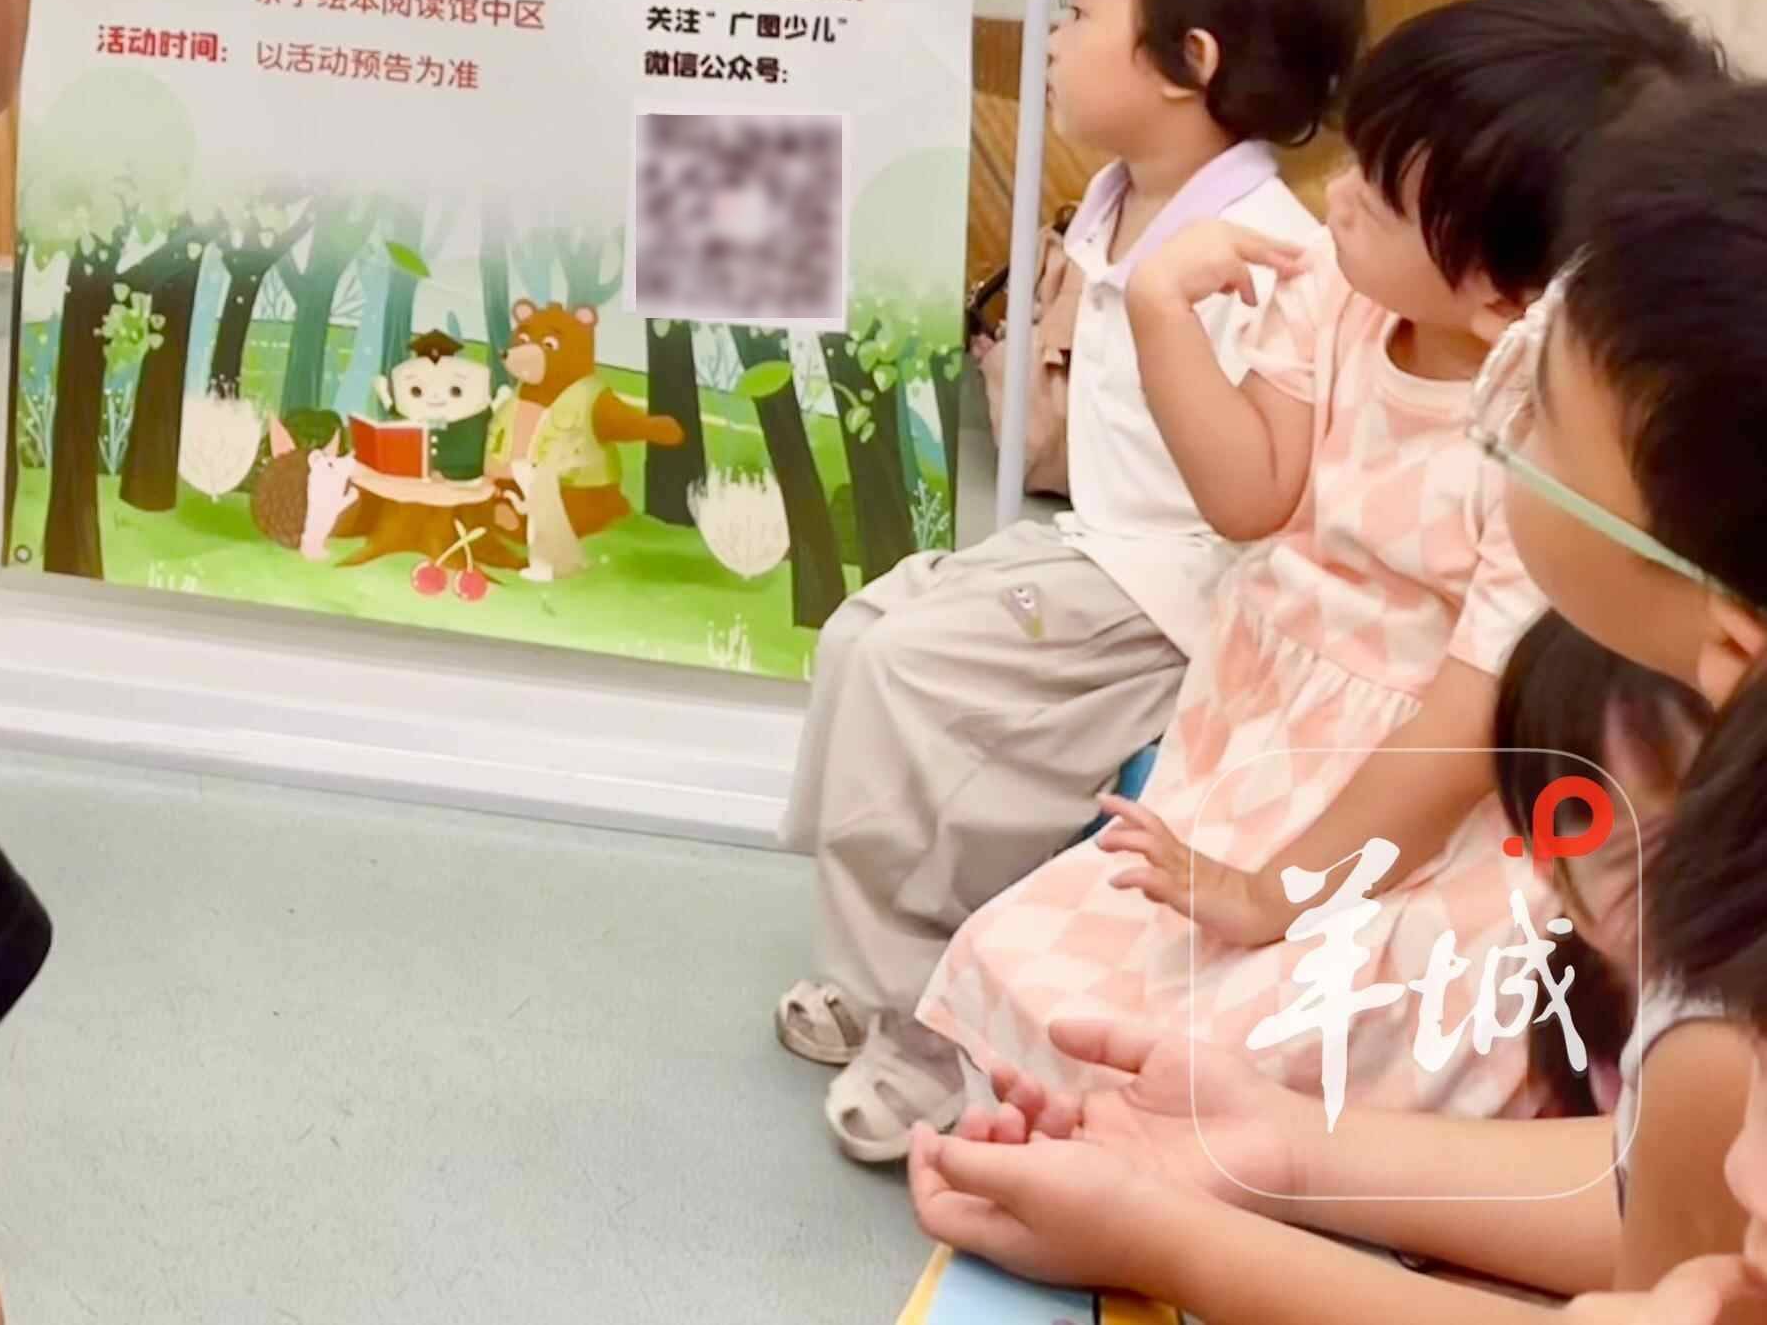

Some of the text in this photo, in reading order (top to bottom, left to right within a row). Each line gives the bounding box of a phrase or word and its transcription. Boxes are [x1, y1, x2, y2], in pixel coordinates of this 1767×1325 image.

[96, 24, 480, 90] 活动时间： 以活动预告为准
[644, 50, 787, 84] 微信公众号：
